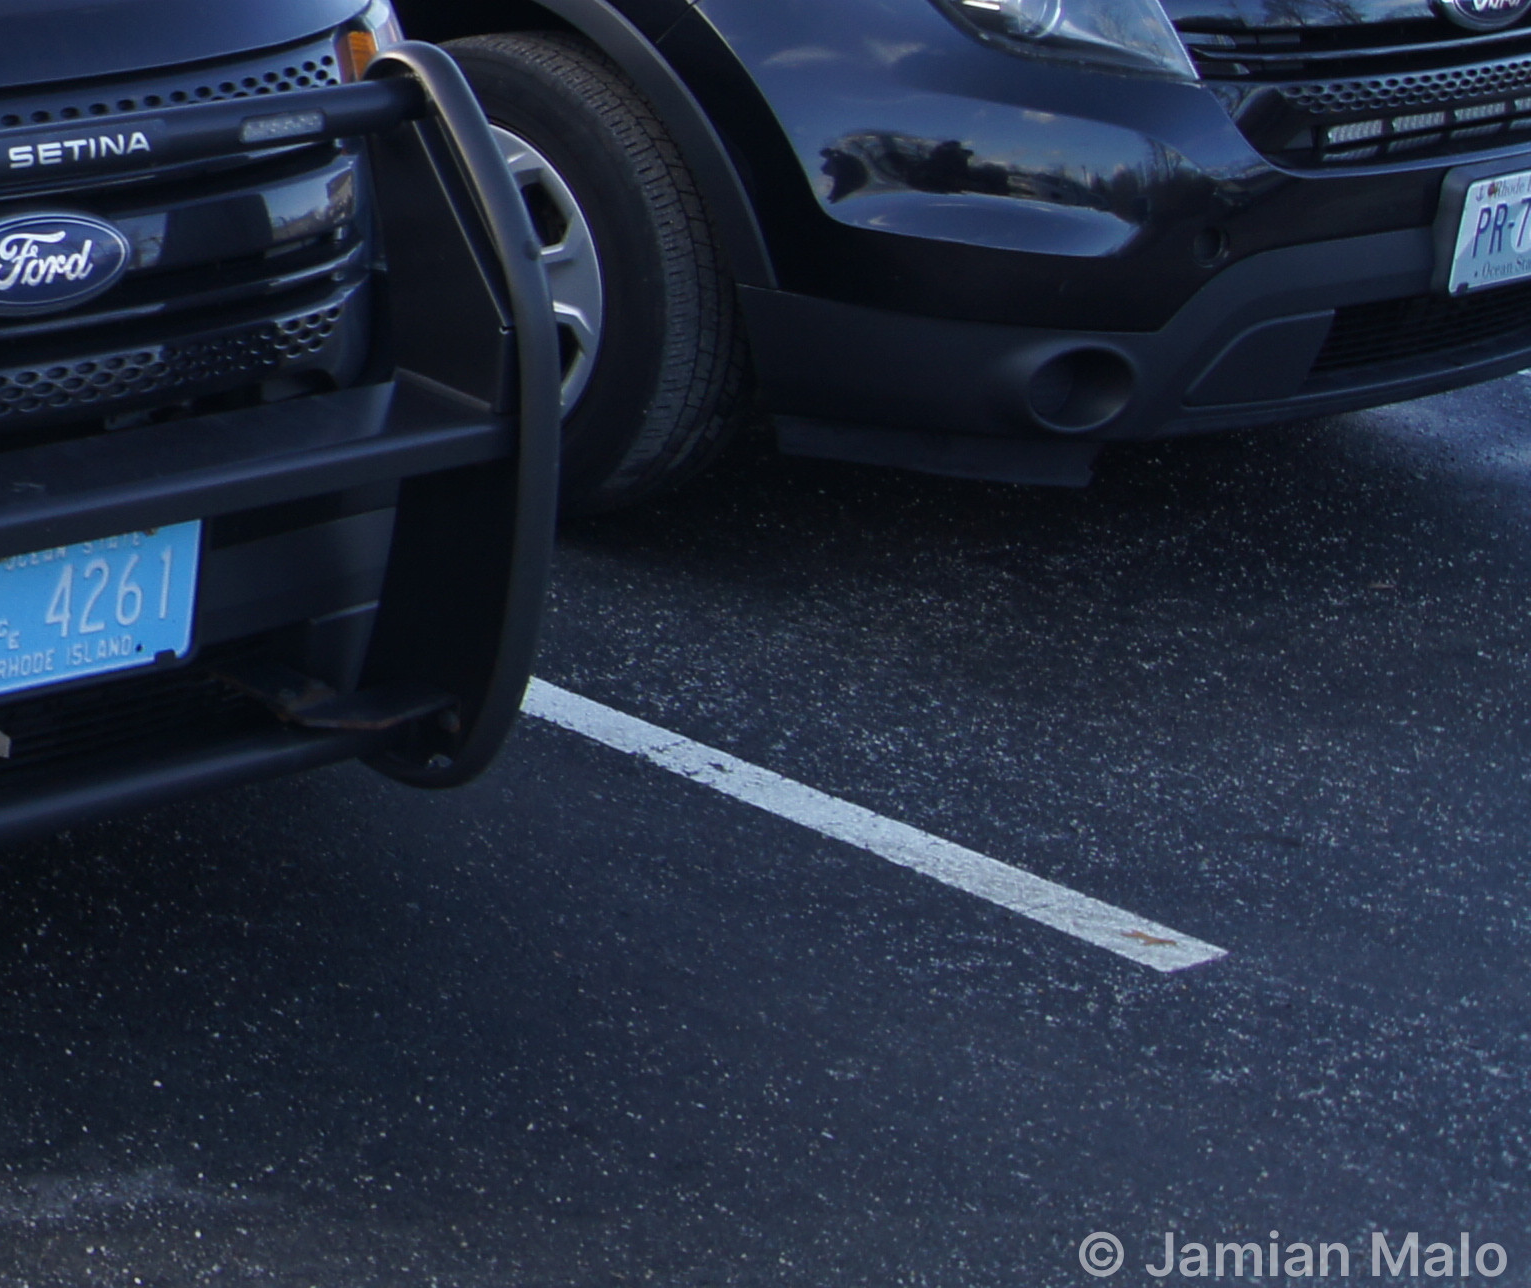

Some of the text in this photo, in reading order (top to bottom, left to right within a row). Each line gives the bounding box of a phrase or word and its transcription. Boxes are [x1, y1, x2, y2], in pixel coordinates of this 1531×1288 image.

[8, 131, 151, 169] SETINA
[44, 544, 174, 639] 4261
[66, 635, 133, 667] ISLAND
